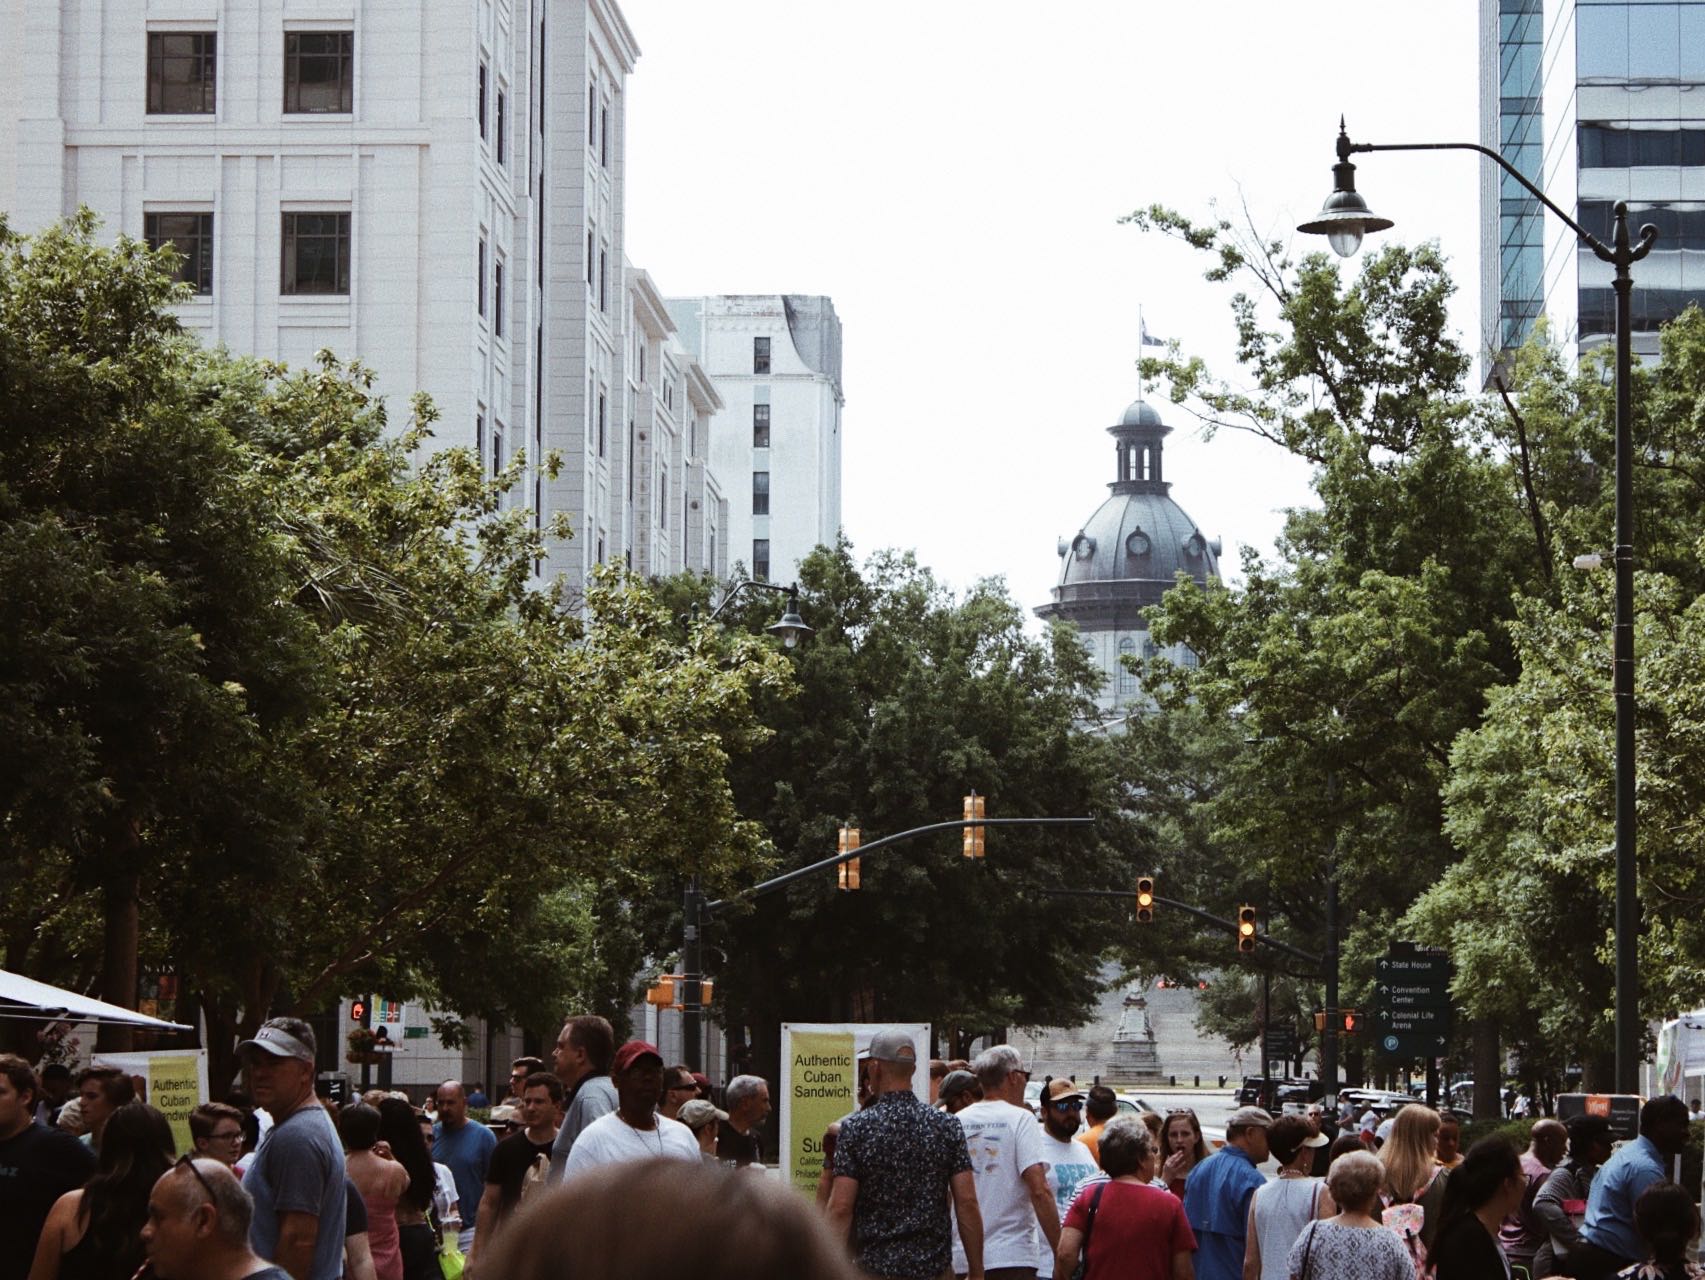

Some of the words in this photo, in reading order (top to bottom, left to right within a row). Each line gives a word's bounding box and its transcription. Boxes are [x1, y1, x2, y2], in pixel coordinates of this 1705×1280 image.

[1391, 961, 1409, 969] State
[1411, 961, 1432, 969] House
[1392, 985, 1430, 994] Convention
[1392, 996, 1415, 1004] Center
[1392, 1011, 1420, 1019] Colonial
[1421, 1011, 1434, 1019] Life
[1392, 1021, 1412, 1030] Arena
[794, 1054, 851, 1067] Authentic
[803, 1071, 842, 1083] Cuban
[152, 1079, 197, 1091] Authentic
[794, 1086, 851, 1098] Sandwich
[160, 1094, 191, 1107] Cuban
[802, 1136, 823, 1153] Su
[799, 1157, 824, 1167] Califor
